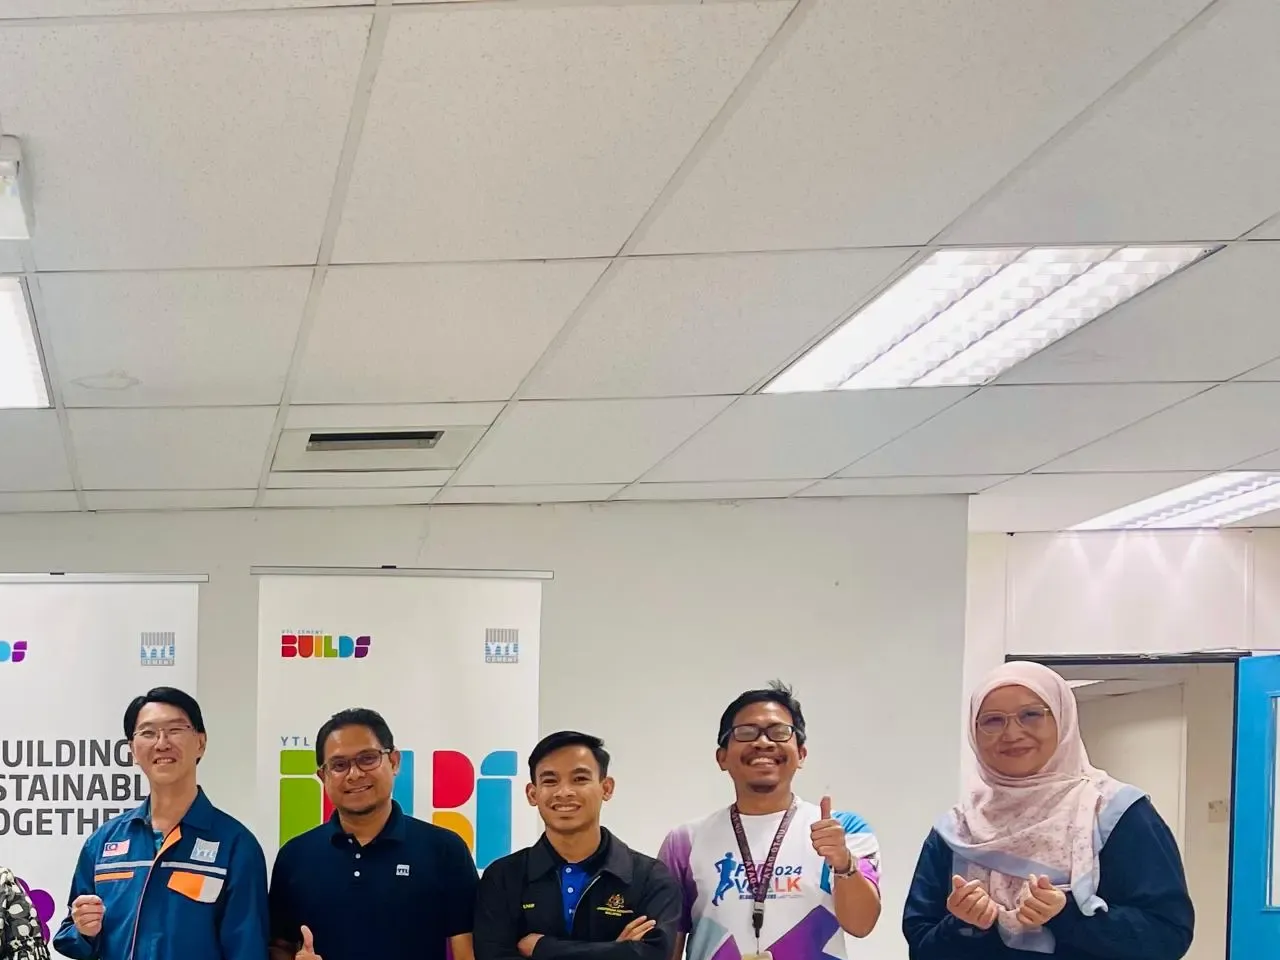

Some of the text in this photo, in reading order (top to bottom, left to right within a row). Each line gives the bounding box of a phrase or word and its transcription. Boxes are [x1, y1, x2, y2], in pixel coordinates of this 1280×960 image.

[141, 645, 175, 659] YTL
[281, 635, 370, 658] BUILDS
[485, 642, 519, 656] YTL
[281, 736, 310, 746] YTL
[774, 865, 803, 876] 024
